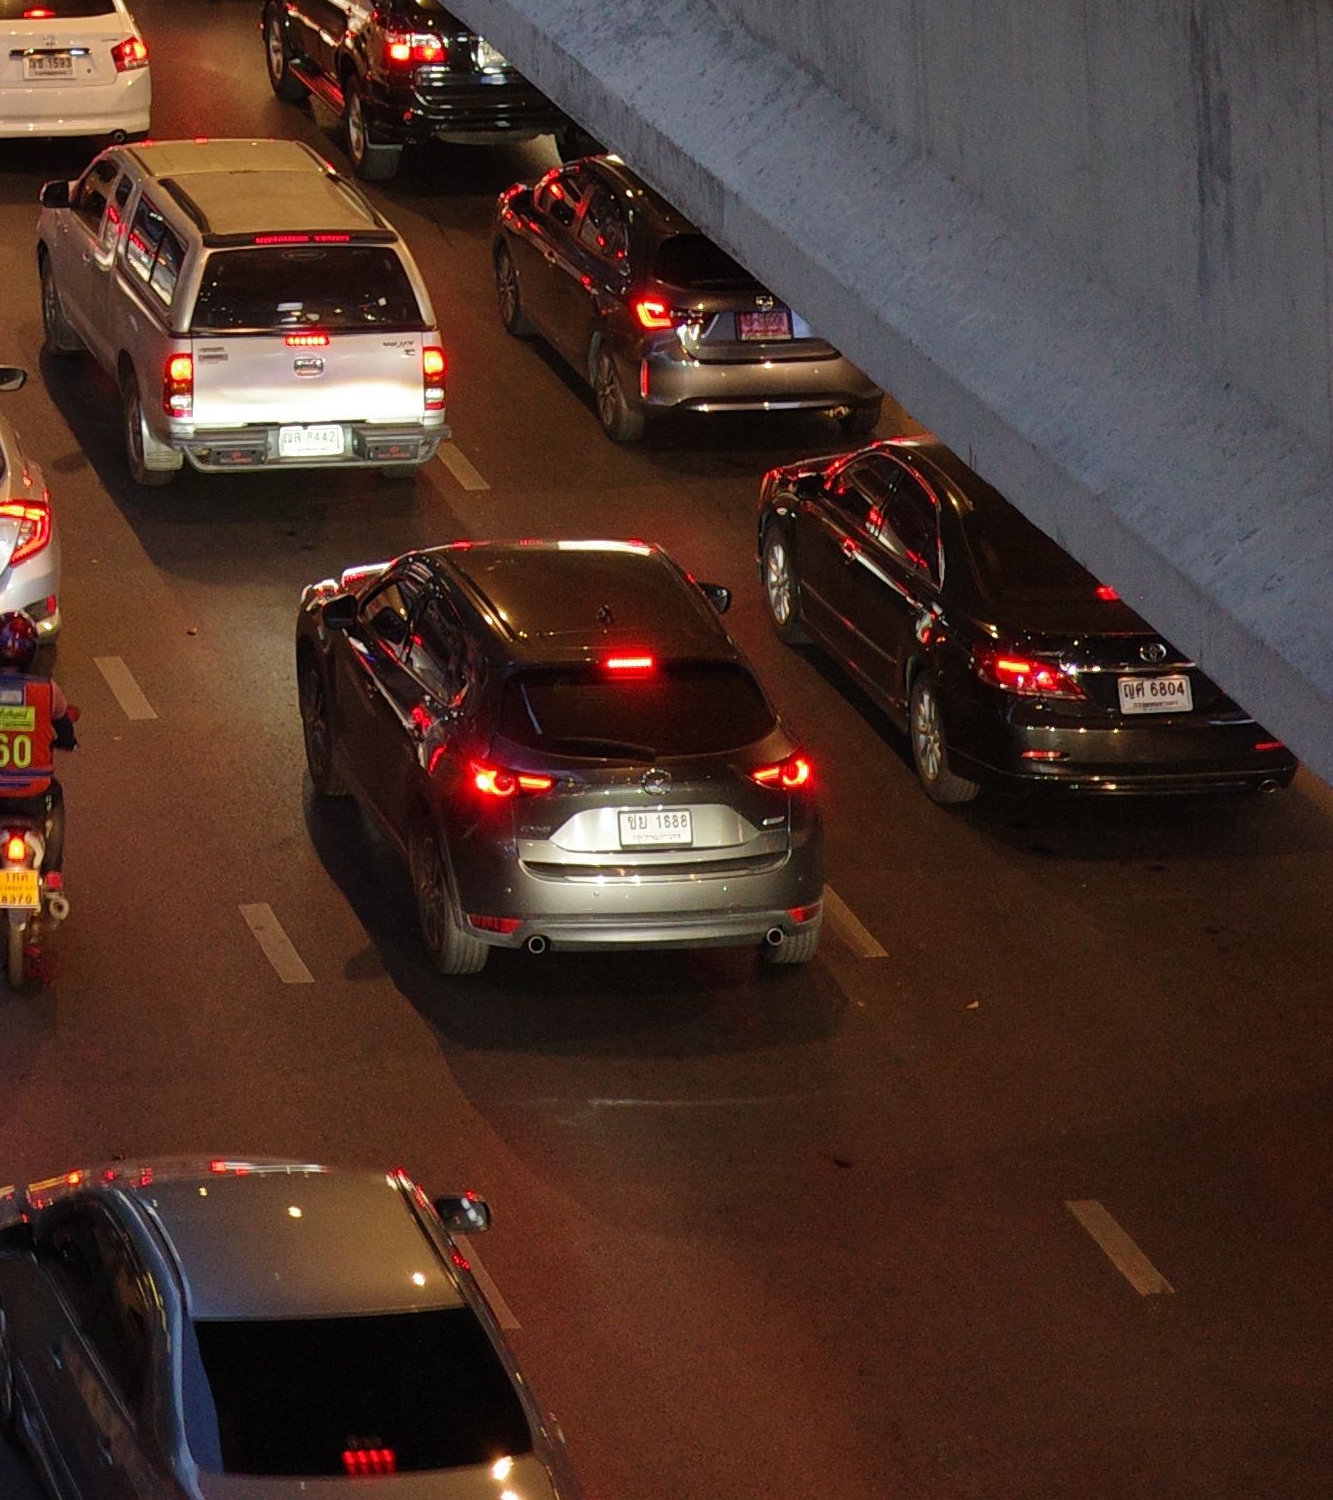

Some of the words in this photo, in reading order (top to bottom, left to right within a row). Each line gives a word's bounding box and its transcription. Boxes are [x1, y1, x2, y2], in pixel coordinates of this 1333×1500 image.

[306, 430, 336, 443] 8442
[1150, 681, 1185, 697] 6804
[656, 814, 688, 829] 1688
